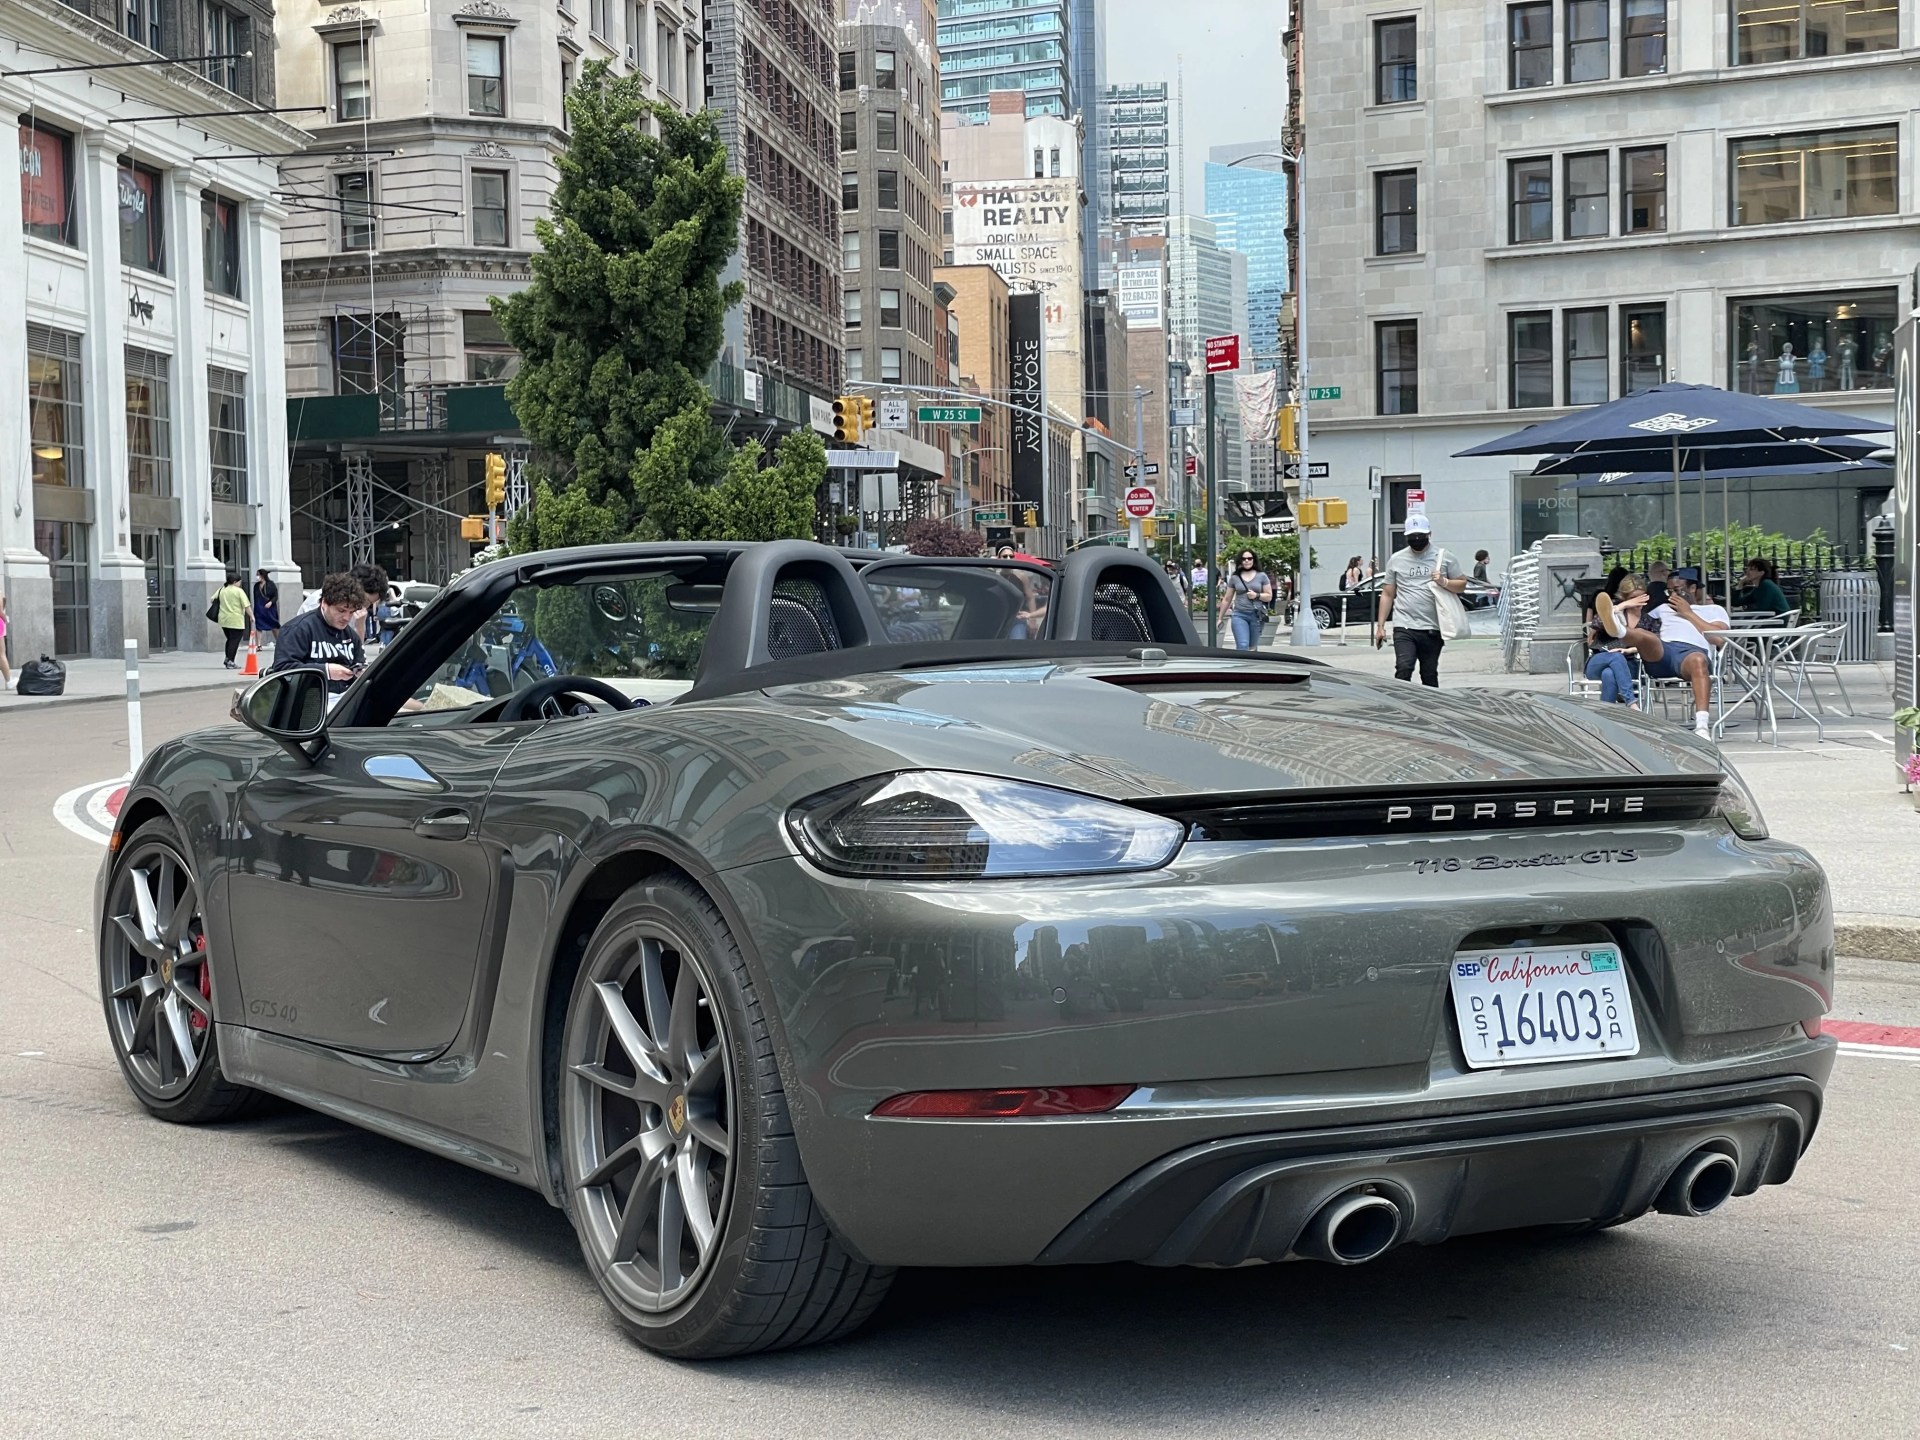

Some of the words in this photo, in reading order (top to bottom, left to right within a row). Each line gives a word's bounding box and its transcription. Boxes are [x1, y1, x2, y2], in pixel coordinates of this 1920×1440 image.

[983, 206, 1069, 226] REALTY
[976, 248, 1015, 261] SMALL
[1021, 247, 1057, 259] SPACE
[1130, 279, 1142, 287] THIS
[1137, 270, 1157, 278] SPACE
[1214, 338, 1234, 348] STANDING
[1014, 355, 1022, 394] PLAZA
[1025, 340, 1040, 452] BROADWAY
[1310, 389, 1318, 399] W
[1321, 388, 1330, 398] 25
[932, 410, 941, 420] W
[944, 410, 954, 420] 25
[958, 410, 967, 420] St
[1014, 400, 1023, 440] HOTEL
[1409, 565, 1430, 577] GAP
[1387, 796, 1644, 823] PORSCHE
[1413, 857, 1462, 875] 718
[1471, 852, 1574, 870] Boxster
[1580, 849, 1639, 864] GTS
[1457, 962, 1481, 977] SEP
[1487, 955, 1592, 988] California
[250, 999, 277, 1018] GTS
[1491, 988, 1602, 1048] 16403
